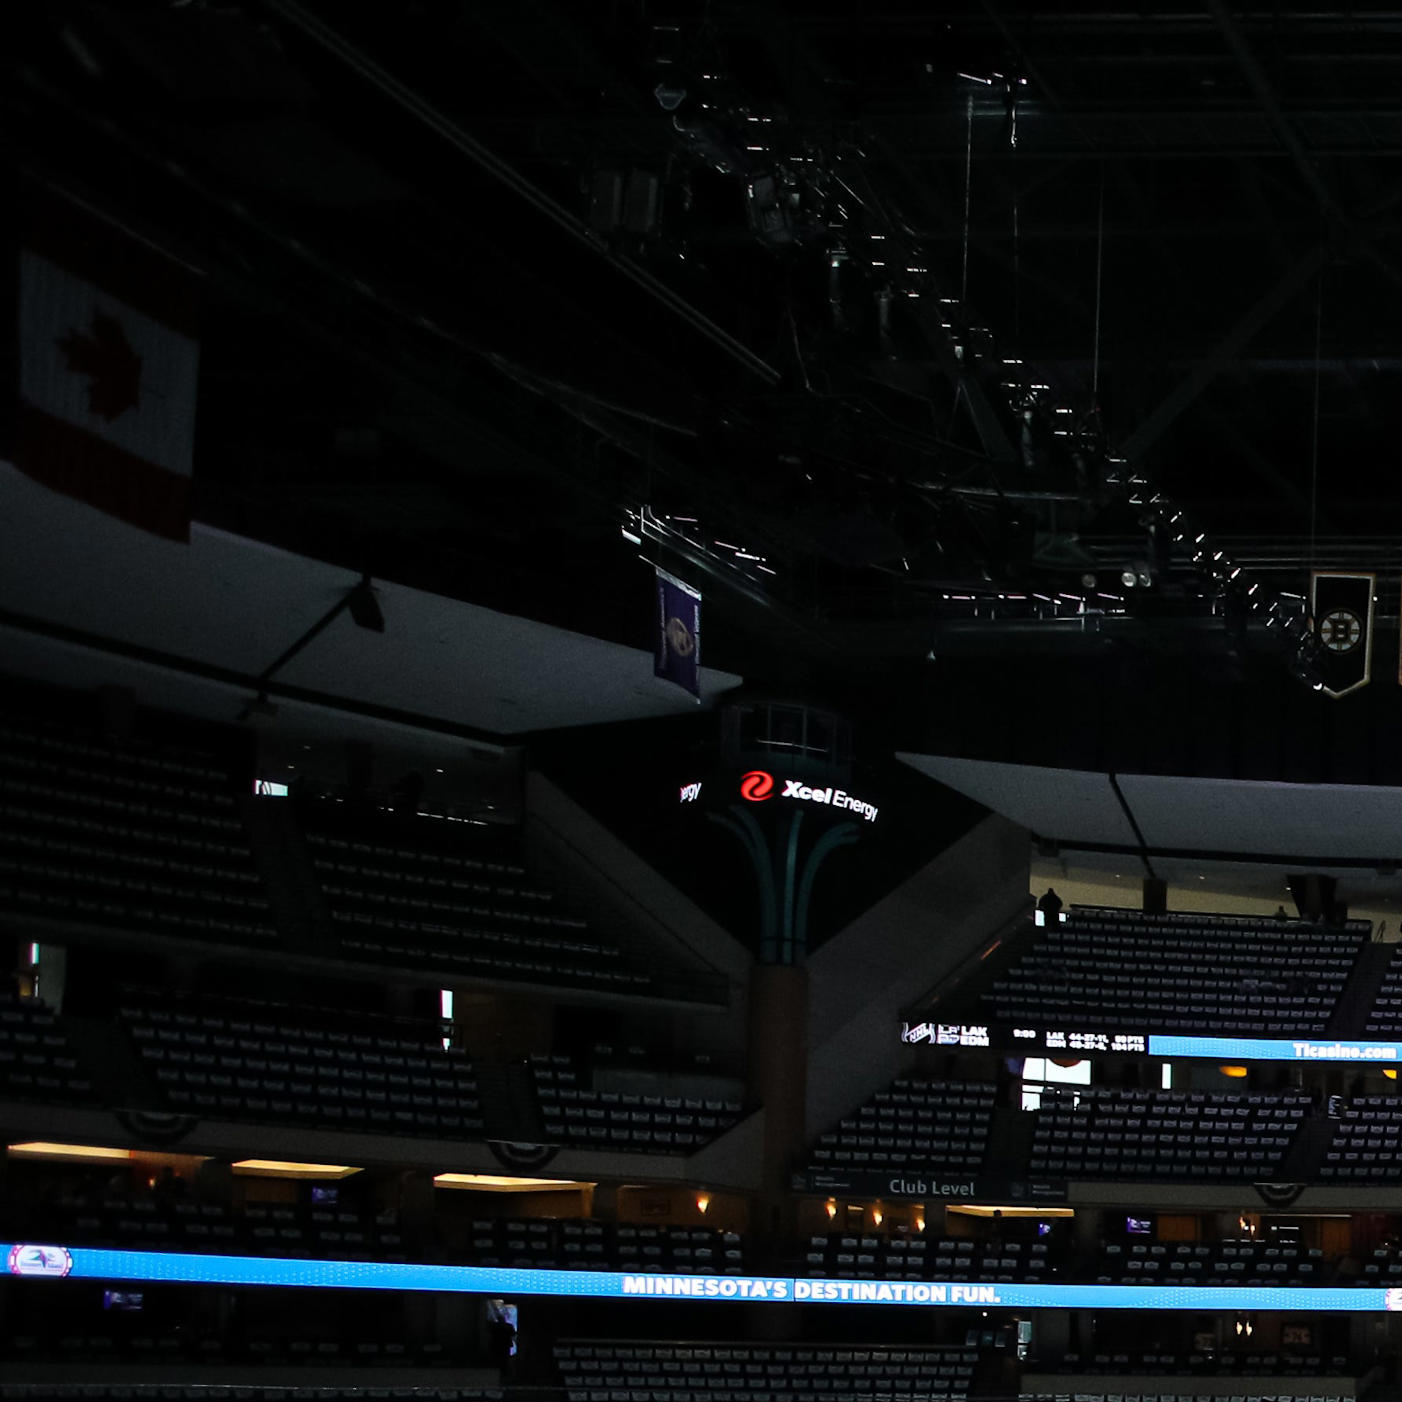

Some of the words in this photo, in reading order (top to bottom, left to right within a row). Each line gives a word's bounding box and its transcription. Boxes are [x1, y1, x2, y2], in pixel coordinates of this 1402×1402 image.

[782, 780, 832, 804] Xcel
[833, 791, 878, 822] Energy
[962, 1026, 987, 1036] LAK
[961, 1036, 989, 1046] EDM
[889, 1179, 927, 1195] Club
[932, 1180, 975, 1196] Level
[624, 1276, 788, 1299] MINNESOTA'S
[796, 1281, 946, 1302] DESTINATION
[952, 1284, 1001, 1303] FUN.
